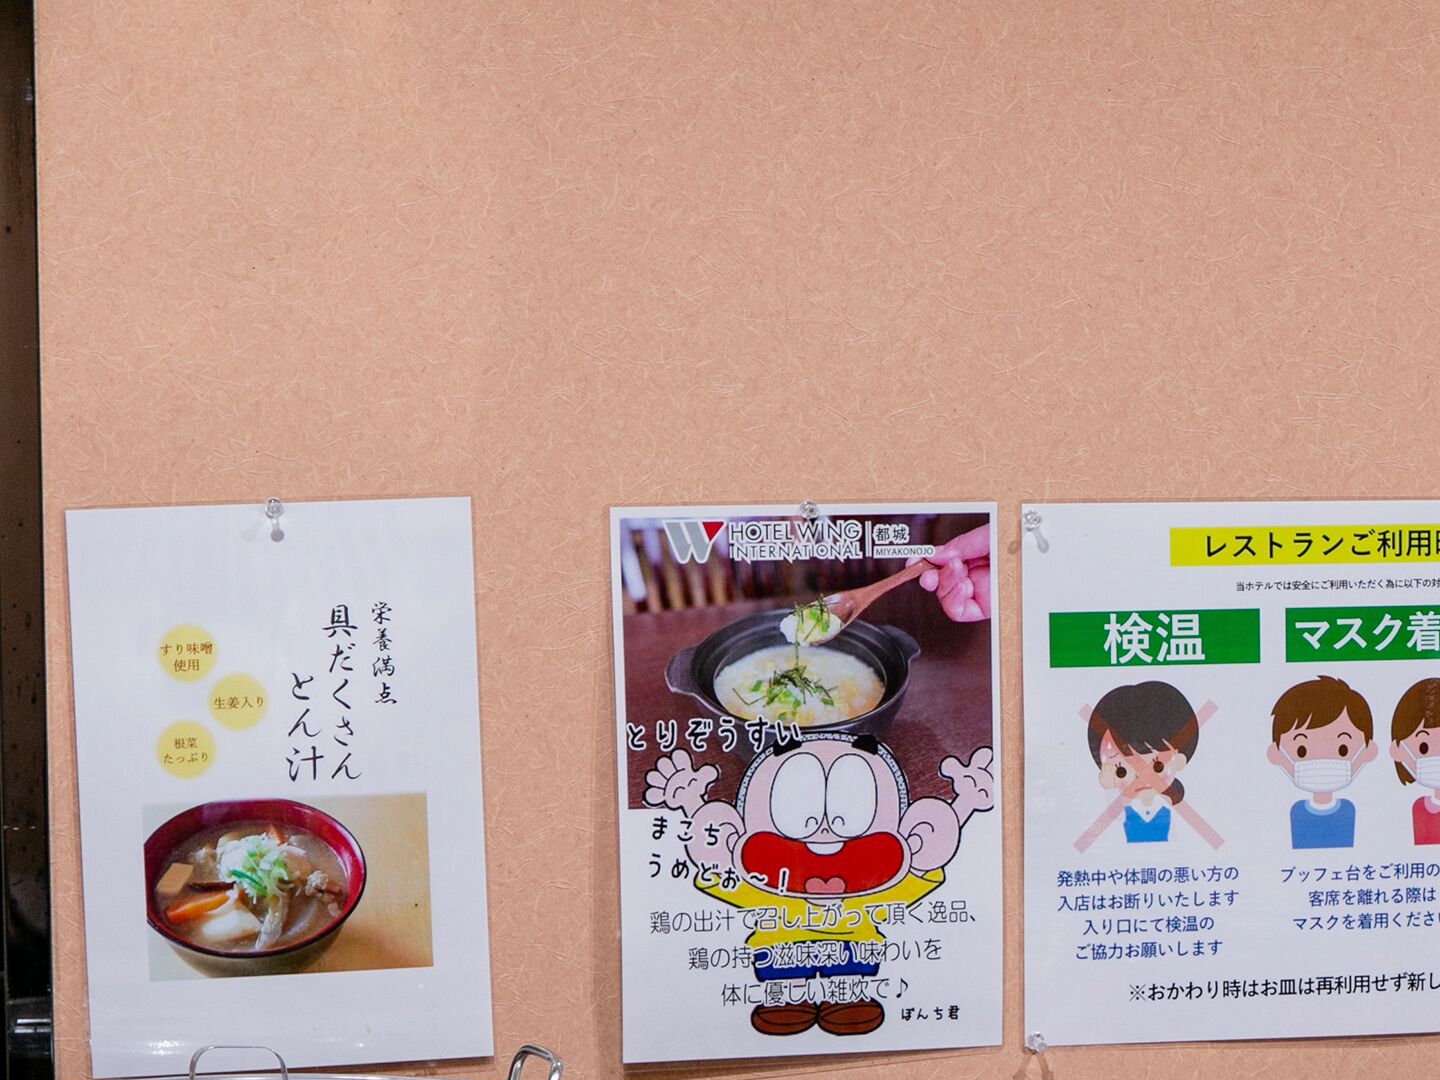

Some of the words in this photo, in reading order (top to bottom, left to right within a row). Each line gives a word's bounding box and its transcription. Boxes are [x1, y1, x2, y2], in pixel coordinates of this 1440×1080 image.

[730, 522, 793, 541] HOTEL
[796, 521, 861, 541] WING
[875, 526, 908, 542] 都城
[730, 543, 861, 559] INTERNATIONAL
[874, 546, 935, 557] MIYAKONOJO
[1103, 612, 1206, 665] 検温
[370, 600, 398, 706] 栄養満点
[173, 658, 201, 673] 使用
[213, 695, 265, 710] 生姜入り
[321, 603, 363, 781] 具だくさん
[284, 671, 324, 784] とん汁
[626, 715, 801, 754] とりぞうすい
[174, 736, 199, 750] 根菜
[162, 751, 209, 765] たっぷり
[651, 815, 721, 847] まこち
[1056, 865, 1240, 888] 発熱中や体調の悪い方の
[1057, 890, 1240, 912] 入店はお断りいたします
[1308, 886, 1437, 908] 客席を離れる際は
[649, 900, 977, 935] 鶏の出汁で召し上がって頂く逸品、
[1083, 915, 1215, 936] 入り口にて検温の
[688, 938, 943, 971] 鶏の持つ滋味深い味わいを
[1075, 939, 1224, 961] ご協力お願いします
